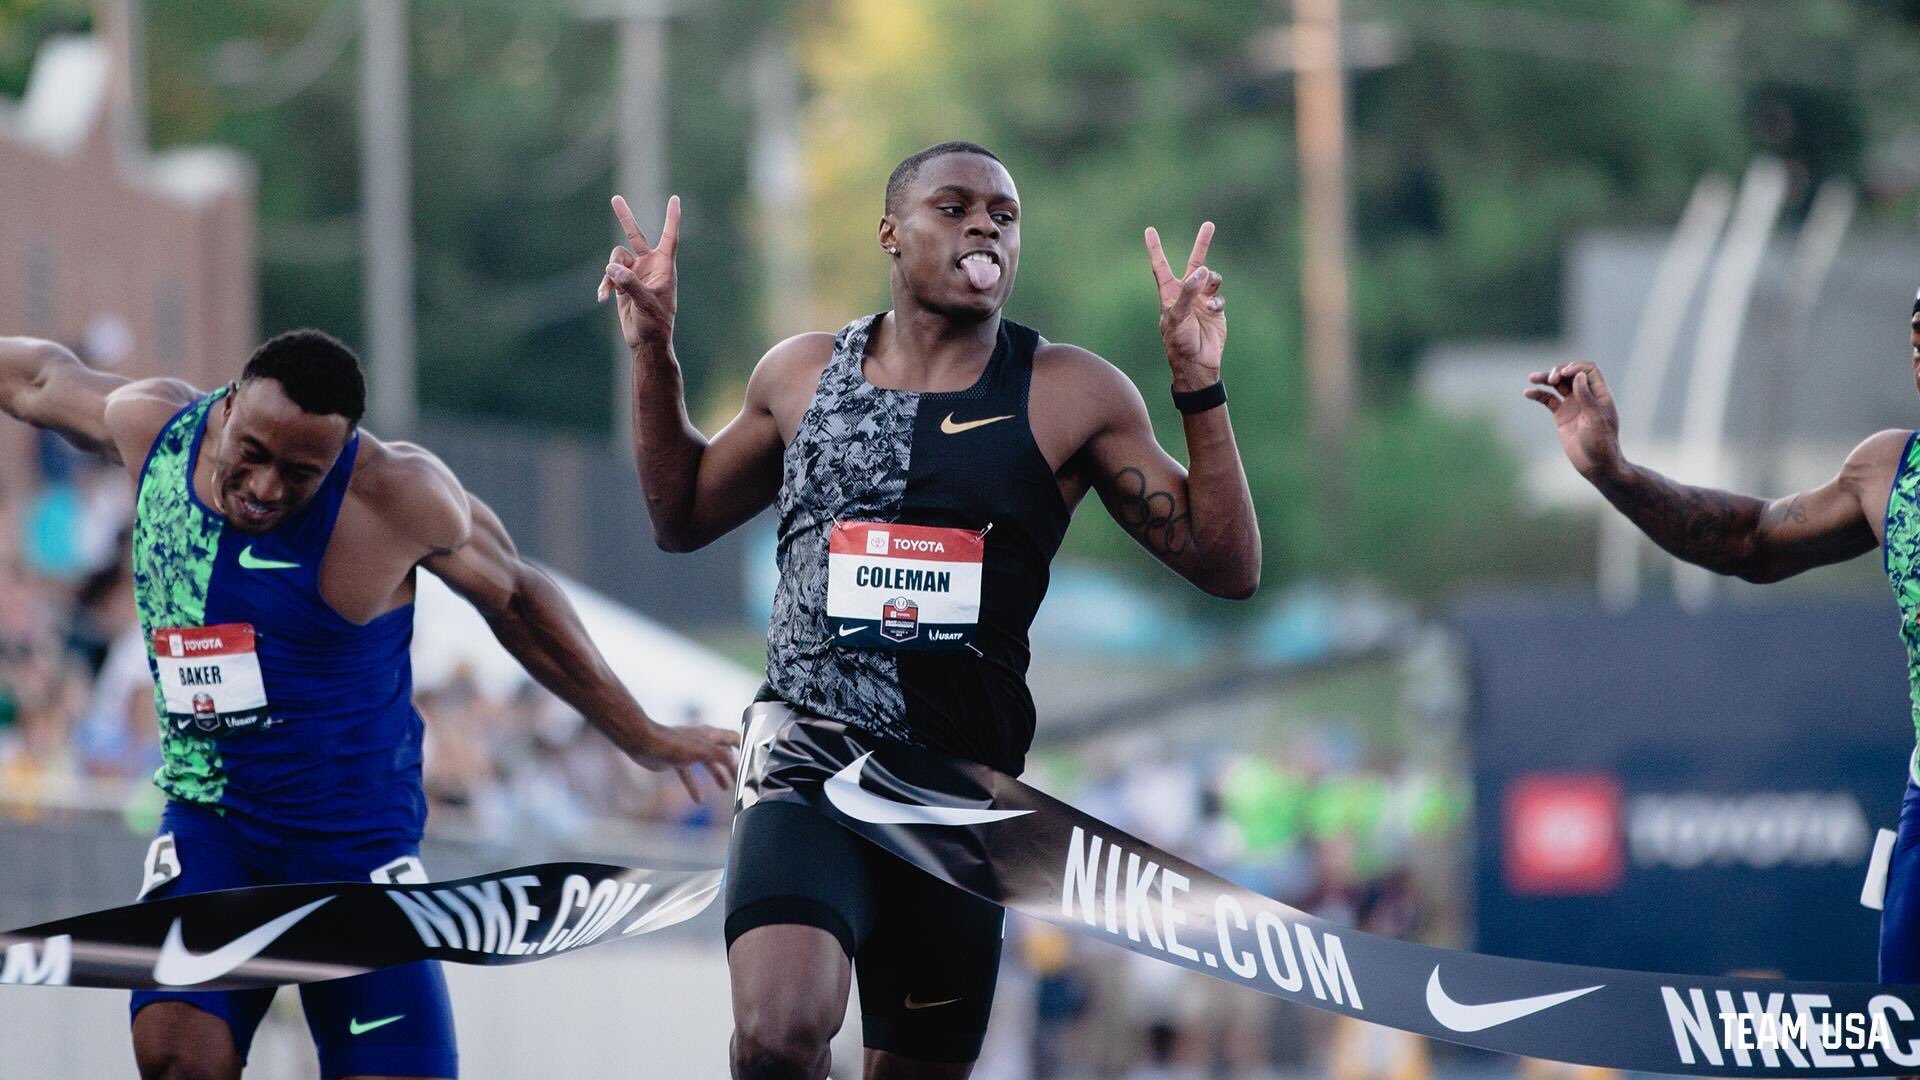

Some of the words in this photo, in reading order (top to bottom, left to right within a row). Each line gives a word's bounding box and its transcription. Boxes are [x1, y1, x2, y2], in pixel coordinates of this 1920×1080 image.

[893, 538, 945, 553] TOYOTA
[856, 565, 951, 593] COLEMAN
[184, 638, 223, 651] TOYOTA
[178, 665, 222, 687] BAKER
[152, 839, 174, 878] 5
[1062, 825, 1363, 1011] NIKE.COM
